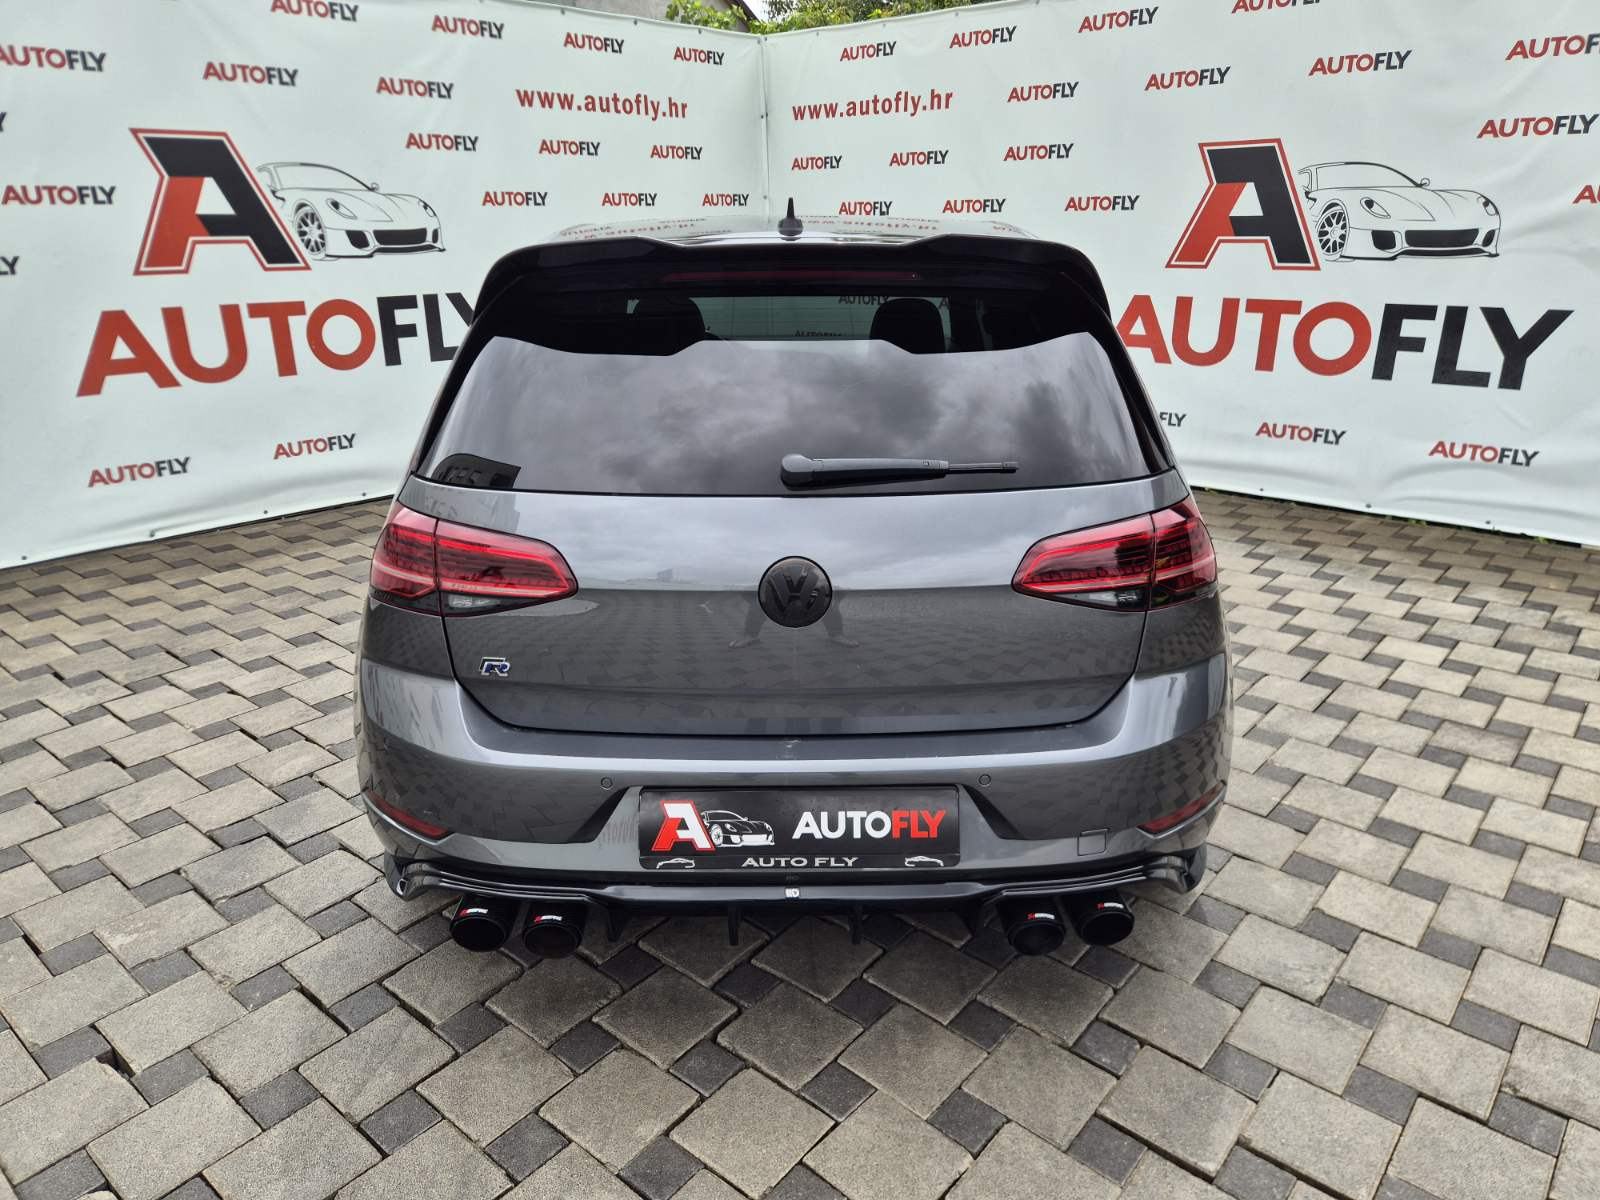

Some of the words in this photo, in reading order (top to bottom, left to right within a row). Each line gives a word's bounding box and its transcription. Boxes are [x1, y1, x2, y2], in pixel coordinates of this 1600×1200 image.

[271, 0, 358, 22] AUTOFLY
[1078, 7, 1159, 33] AUTOFLY
[432, 15, 504, 39] AUTOFLY
[949, 26, 1017, 48] AUTOFLY
[564, 32, 624, 54] AUTOFLY
[840, 41, 896, 61] AUTOFLY
[1505, 33, 1600, 60] AUTOF
[674, 47, 724, 65] AUTOFLY
[1309, 50, 1412, 76] AUTOFLY
[203, 62, 298, 87] AUTOFLY
[1145, 66, 1231, 91] AUTOFLY
[376, 77, 454, 99] AUTOFLY
[1008, 82, 1079, 102] AUTOFLY
[516, 89, 687, 121] www.autofly.hr
[792, 89, 953, 120] www.autofly.hr
[1477, 114, 1599, 138] AUTOFLY
[406, 133, 478, 152] AUTOFLY
[539, 139, 600, 156] AUTOFLY
[651, 145, 702, 160] AUTOFLY
[1004, 143, 1074, 161] AUTOFLY
[792, 155, 842, 170] AUTOFLY
[889, 150, 949, 166] AUTOFLY
[2, 185, 116, 205] AUTOFLY
[482, 192, 547, 206] AUTOFLY
[602, 193, 657, 206] AUTOFLY
[703, 194, 749, 206] AUTOFLY
[943, 199, 1006, 213] AUTOFLY
[1065, 195, 1140, 211] AUTOFLY
[839, 201, 892, 216] AUTOFLY
[1115, 295, 1574, 390] AUTOFLY
[1256, 422, 1346, 445] AUTOFLY
[274, 433, 356, 459] AUTOFLY
[1429, 441, 1539, 467] AUTOFLY
[88, 457, 190, 487] AUTOFLY
[480, 656, 510, 677] R
[792, 810, 946, 839] AUTOFLY
[741, 857, 808, 867] AUTO
[814, 857, 858, 867] FLY
